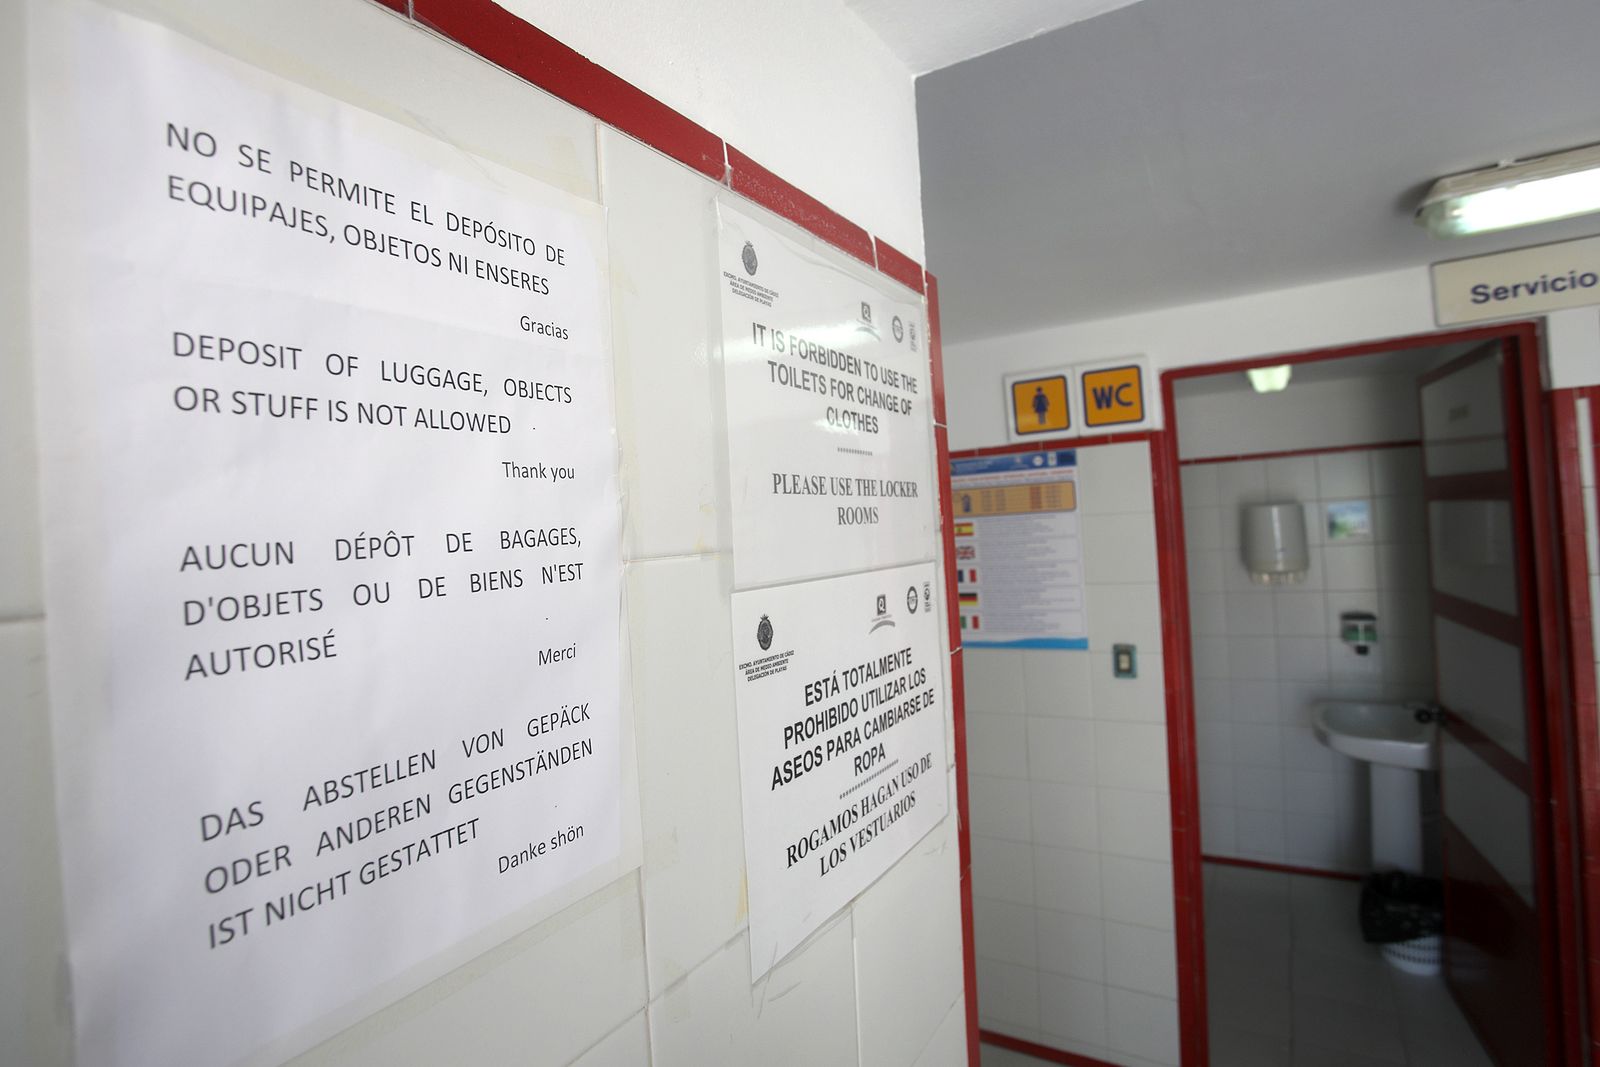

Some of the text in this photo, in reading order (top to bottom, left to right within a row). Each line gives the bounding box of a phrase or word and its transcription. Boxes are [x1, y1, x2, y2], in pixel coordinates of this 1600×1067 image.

[167, 122, 566, 267] NO SE PERMITE EL DEPÓSITO DE
[168, 175, 550, 296] EQUIPAJES, OBJETOS NI ENSERES
[1470, 270, 1599, 305] Servicio
[520, 315, 569, 340] Gracias
[173, 331, 572, 404] DEPOSIT OF LUGGAGE, OBJECTS
[752, 321, 918, 395] IT IS FORBIDDEN TO USE THE
[173, 385, 511, 434] OR STUFF IS NOT ALLOWED
[767, 360, 913, 416] TOILETS FOR CHANGE OF
[1091, 382, 1134, 411] WC
[825, 406, 880, 435] CLOTHES
[501, 461, 575, 483] Thank you
[772, 472, 919, 498] PLEASE USE THE LOCKER
[837, 506, 879, 526] ROOMS
[179, 527, 581, 573] AUCUN DÉPÔT DE BAGAGES,
[183, 562, 584, 627] D'OBJETS OU DE BIENS N'EST
[184, 628, 337, 681] AUTORISÉ
[538, 642, 576, 666] Merci
[804, 647, 913, 707] ESTÁ TOTALMENTE
[783, 667, 926, 750] PROHIBIDO UTILIZAR LOS
[771, 689, 935, 792] ASEOS PARA CAMBIARSE DE
[853, 743, 886, 777] ROPA
[200, 702, 591, 842] DAS ABSTELLEN VON GEPÄCK
[204, 738, 593, 895] ODER ANDEREN GEGENSTÄNDEN
[786, 753, 932, 869] ROGAMOS HAGAN USO DE
[820, 794, 916, 877] LOS VESTUARIOS
[498, 825, 584, 874] Danke shön
[209, 817, 480, 950] IST NICHT GESTATTET
